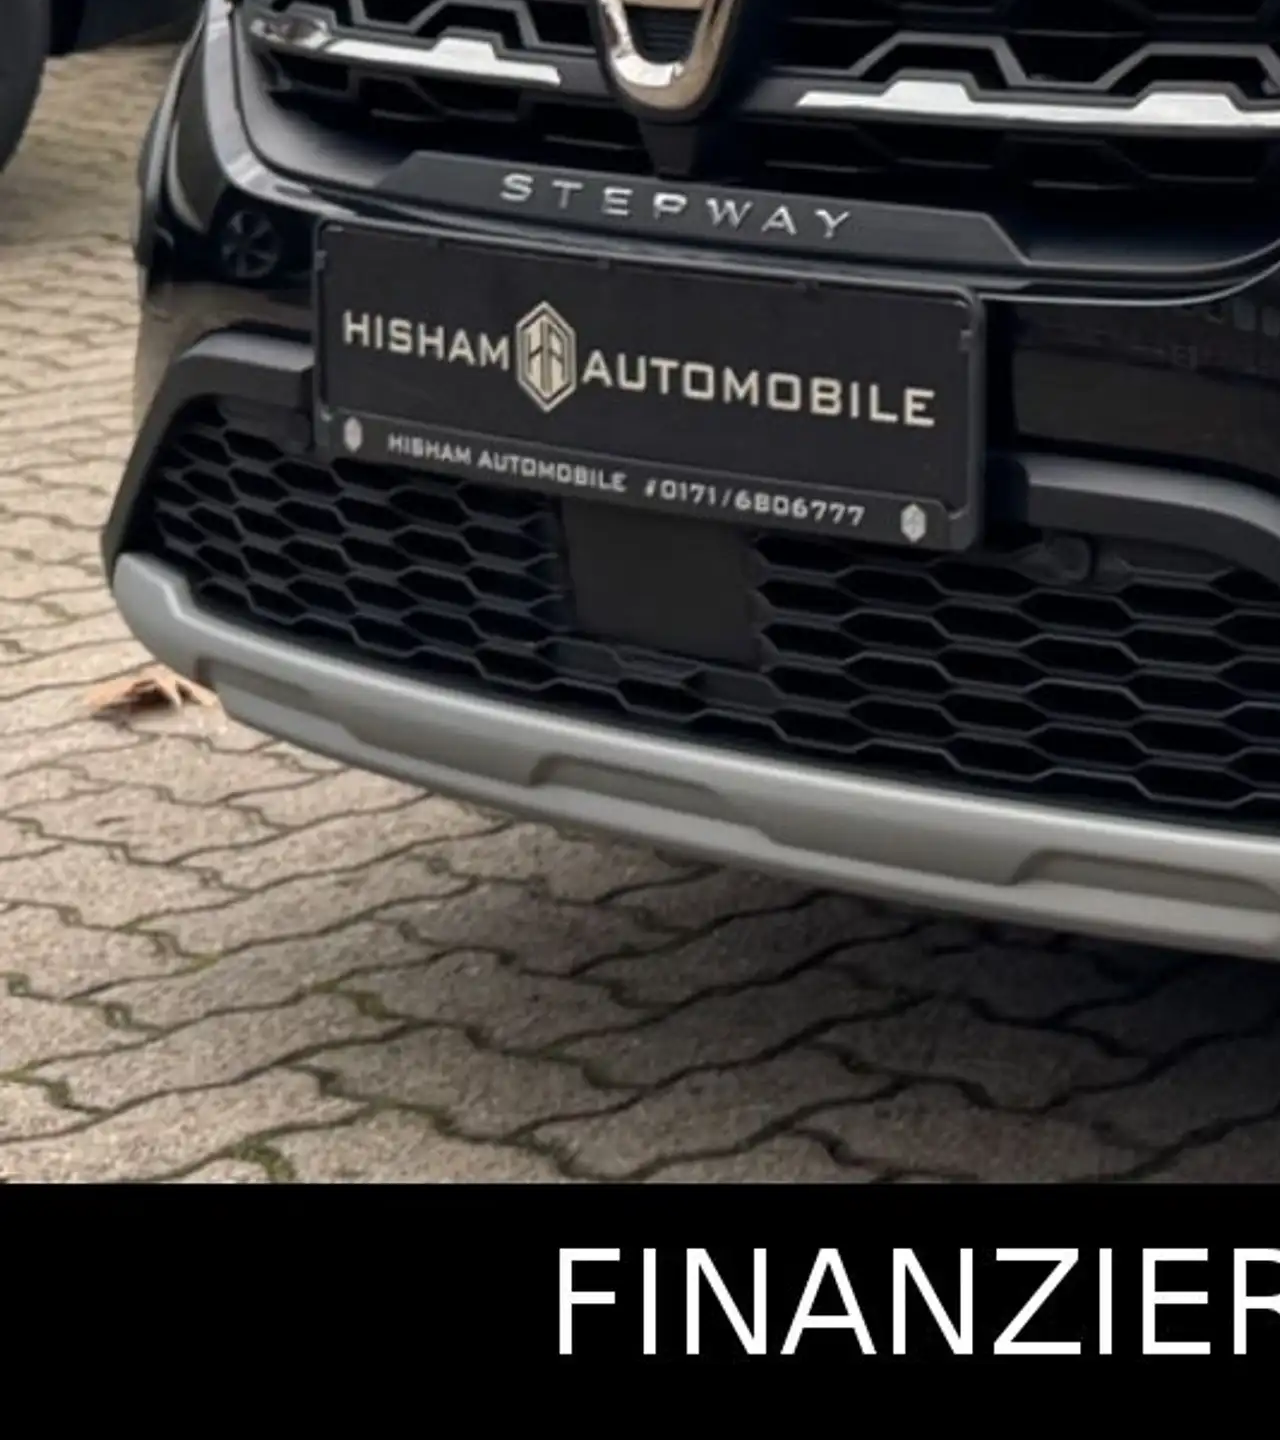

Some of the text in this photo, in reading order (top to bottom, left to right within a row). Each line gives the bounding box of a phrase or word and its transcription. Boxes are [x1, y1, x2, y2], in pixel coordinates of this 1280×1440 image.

[500, 173, 850, 239] STEPWAY
[344, 311, 509, 371] HISHAM
[582, 350, 935, 427] AUTOMOBILE
[388, 434, 472, 464] HISHAM
[477, 450, 626, 493] AUTOMOBILE
